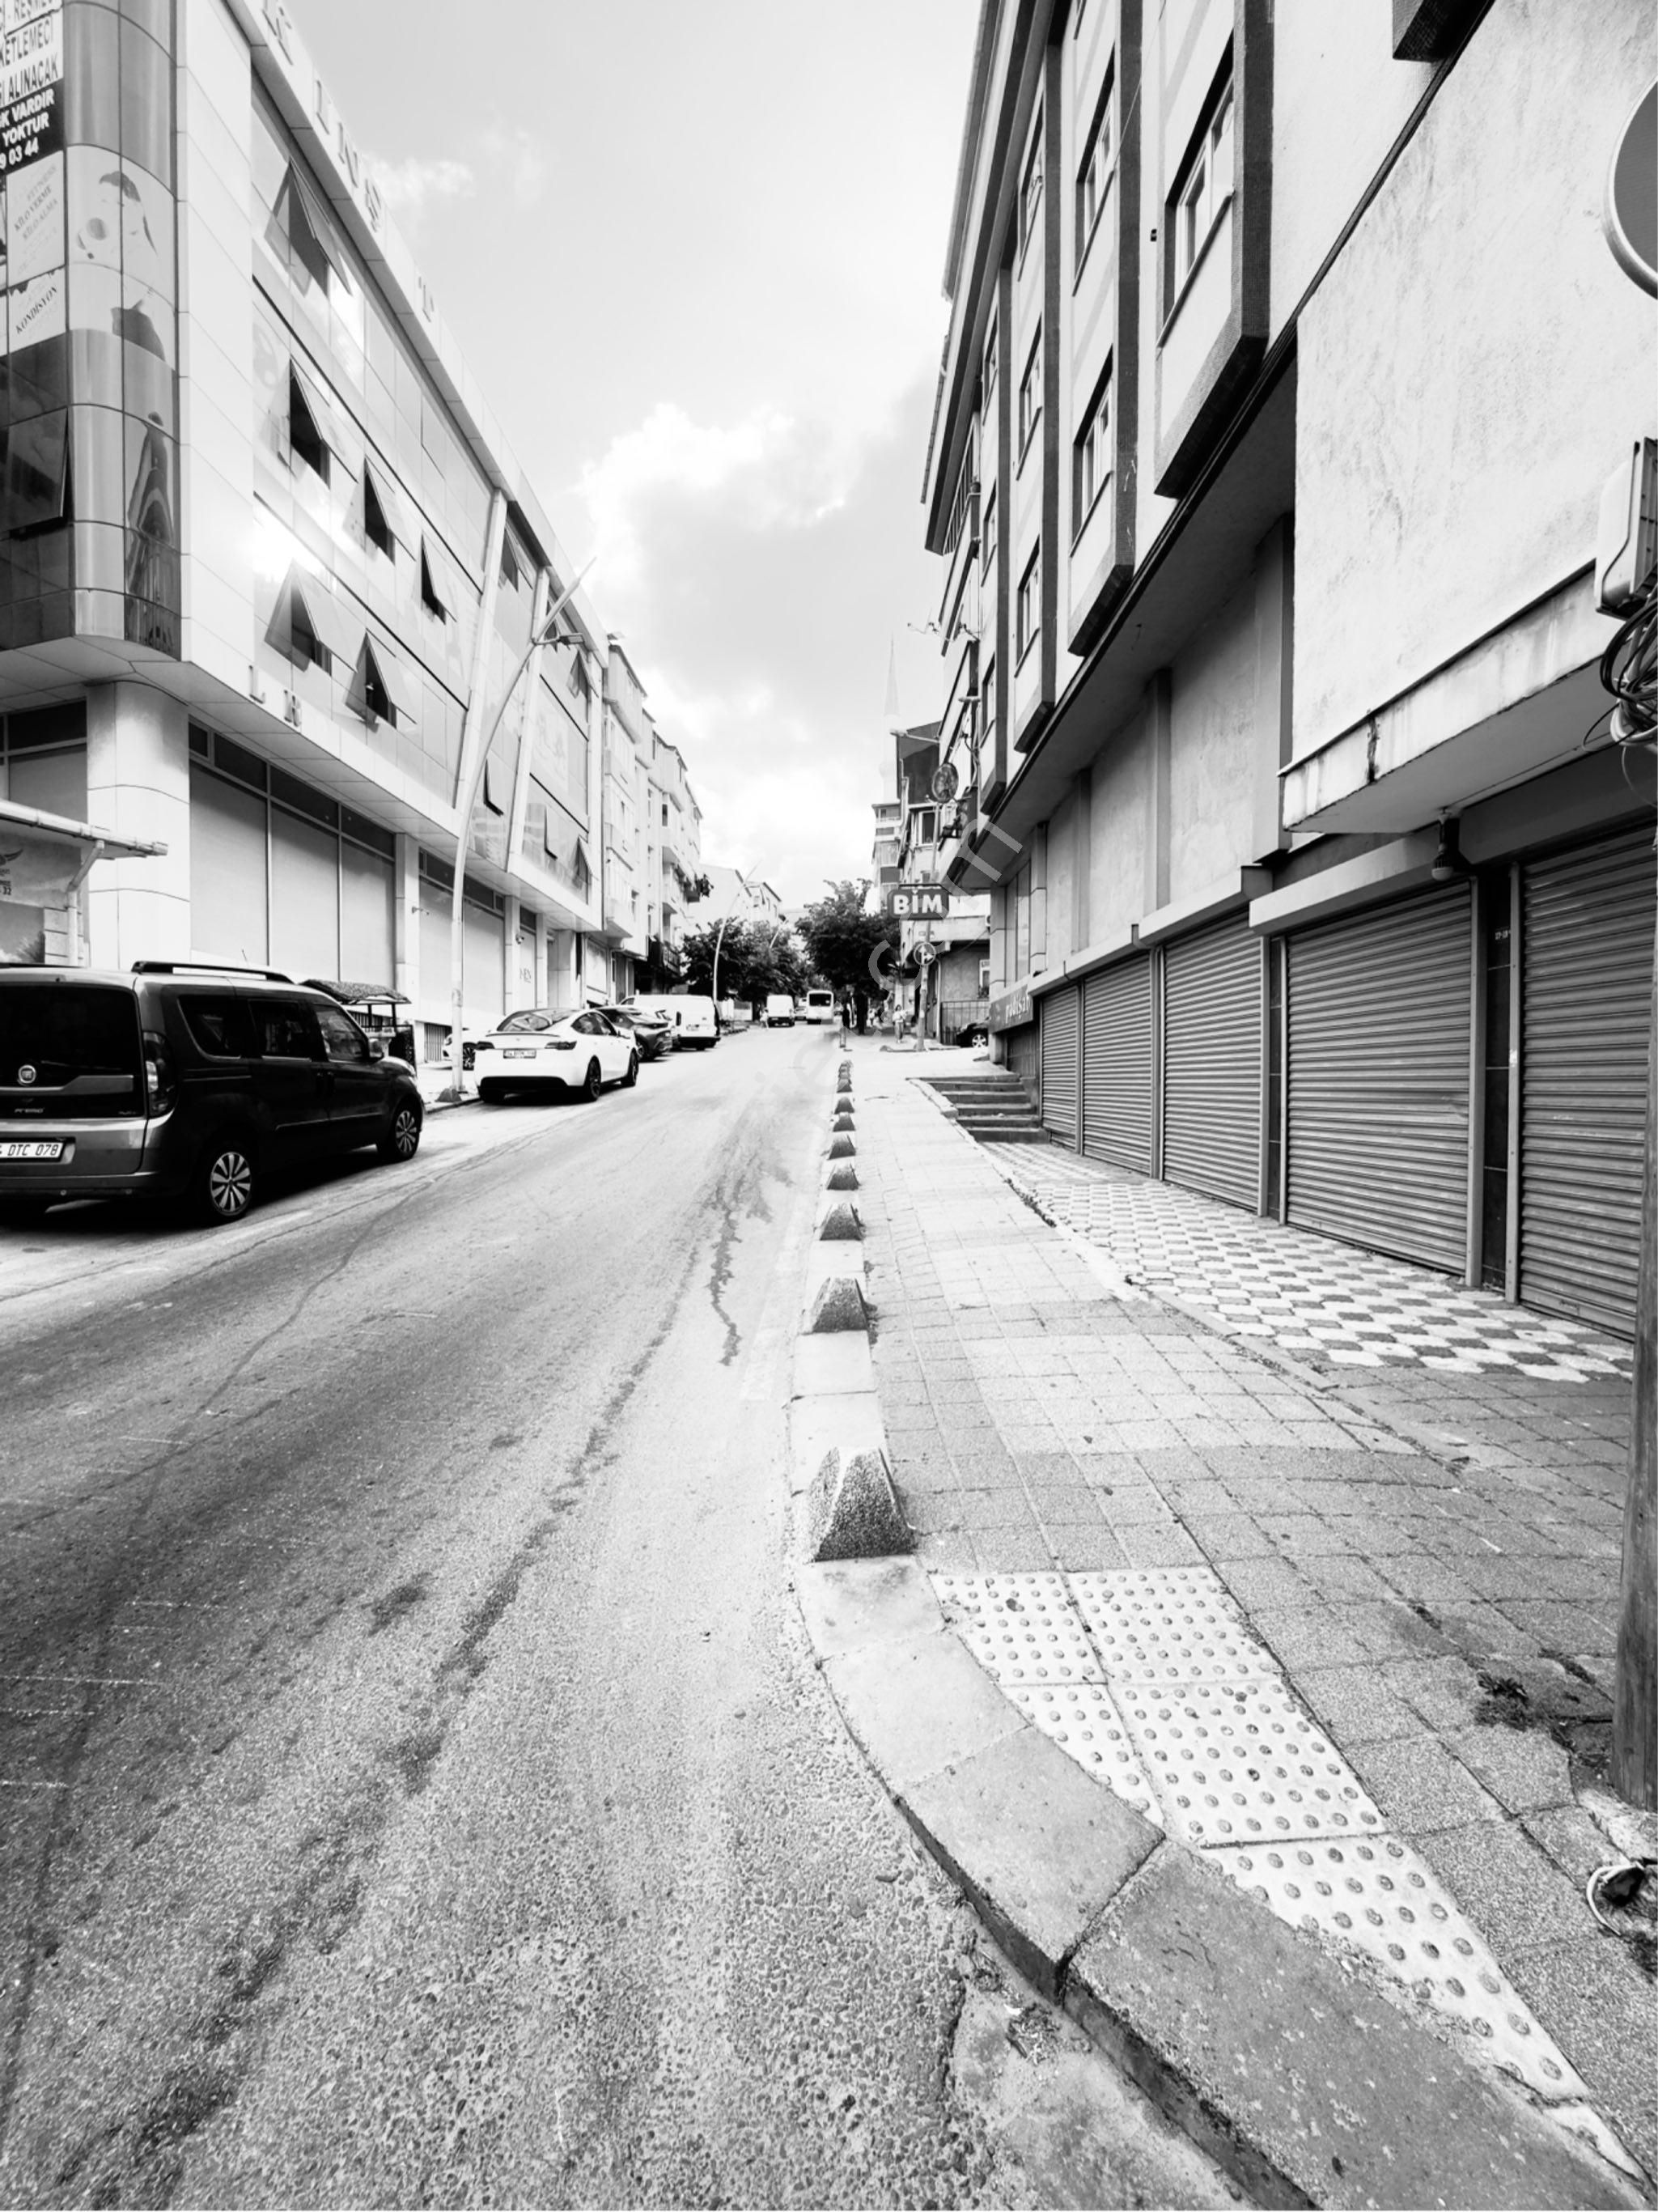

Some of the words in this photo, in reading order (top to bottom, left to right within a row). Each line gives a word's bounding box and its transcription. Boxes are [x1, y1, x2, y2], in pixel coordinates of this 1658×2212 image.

[11, 88, 55, 122] VARDIR
[2, 112, 49, 147] YOKTUR
[893, 889, 943, 915] BİM
[7, 1144, 31, 1157] DTC
[35, 1144, 59, 1157] 078
